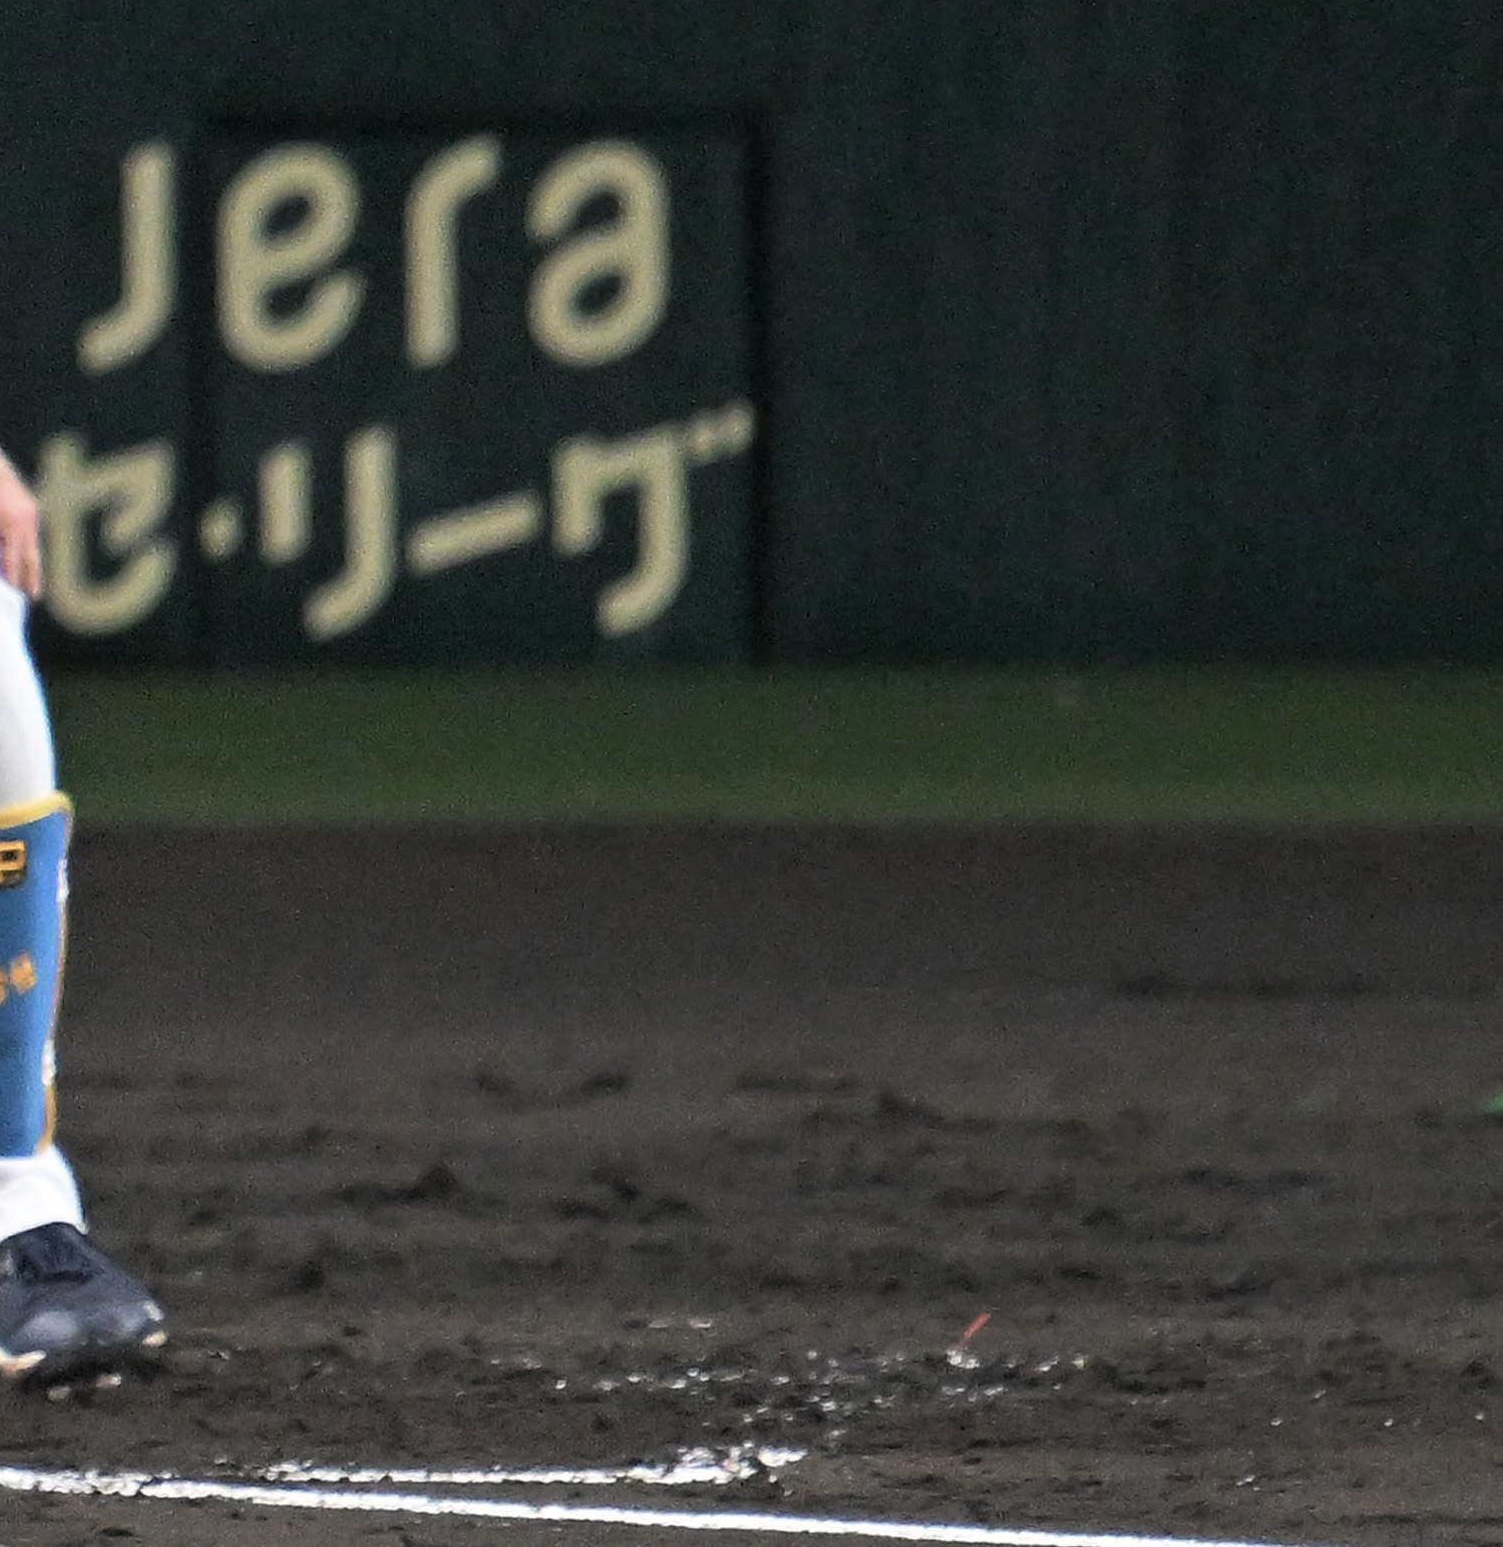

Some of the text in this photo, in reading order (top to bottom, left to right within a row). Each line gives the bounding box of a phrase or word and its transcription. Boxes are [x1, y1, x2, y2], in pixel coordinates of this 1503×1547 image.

[36, 399, 754, 639] セ・リーグ
